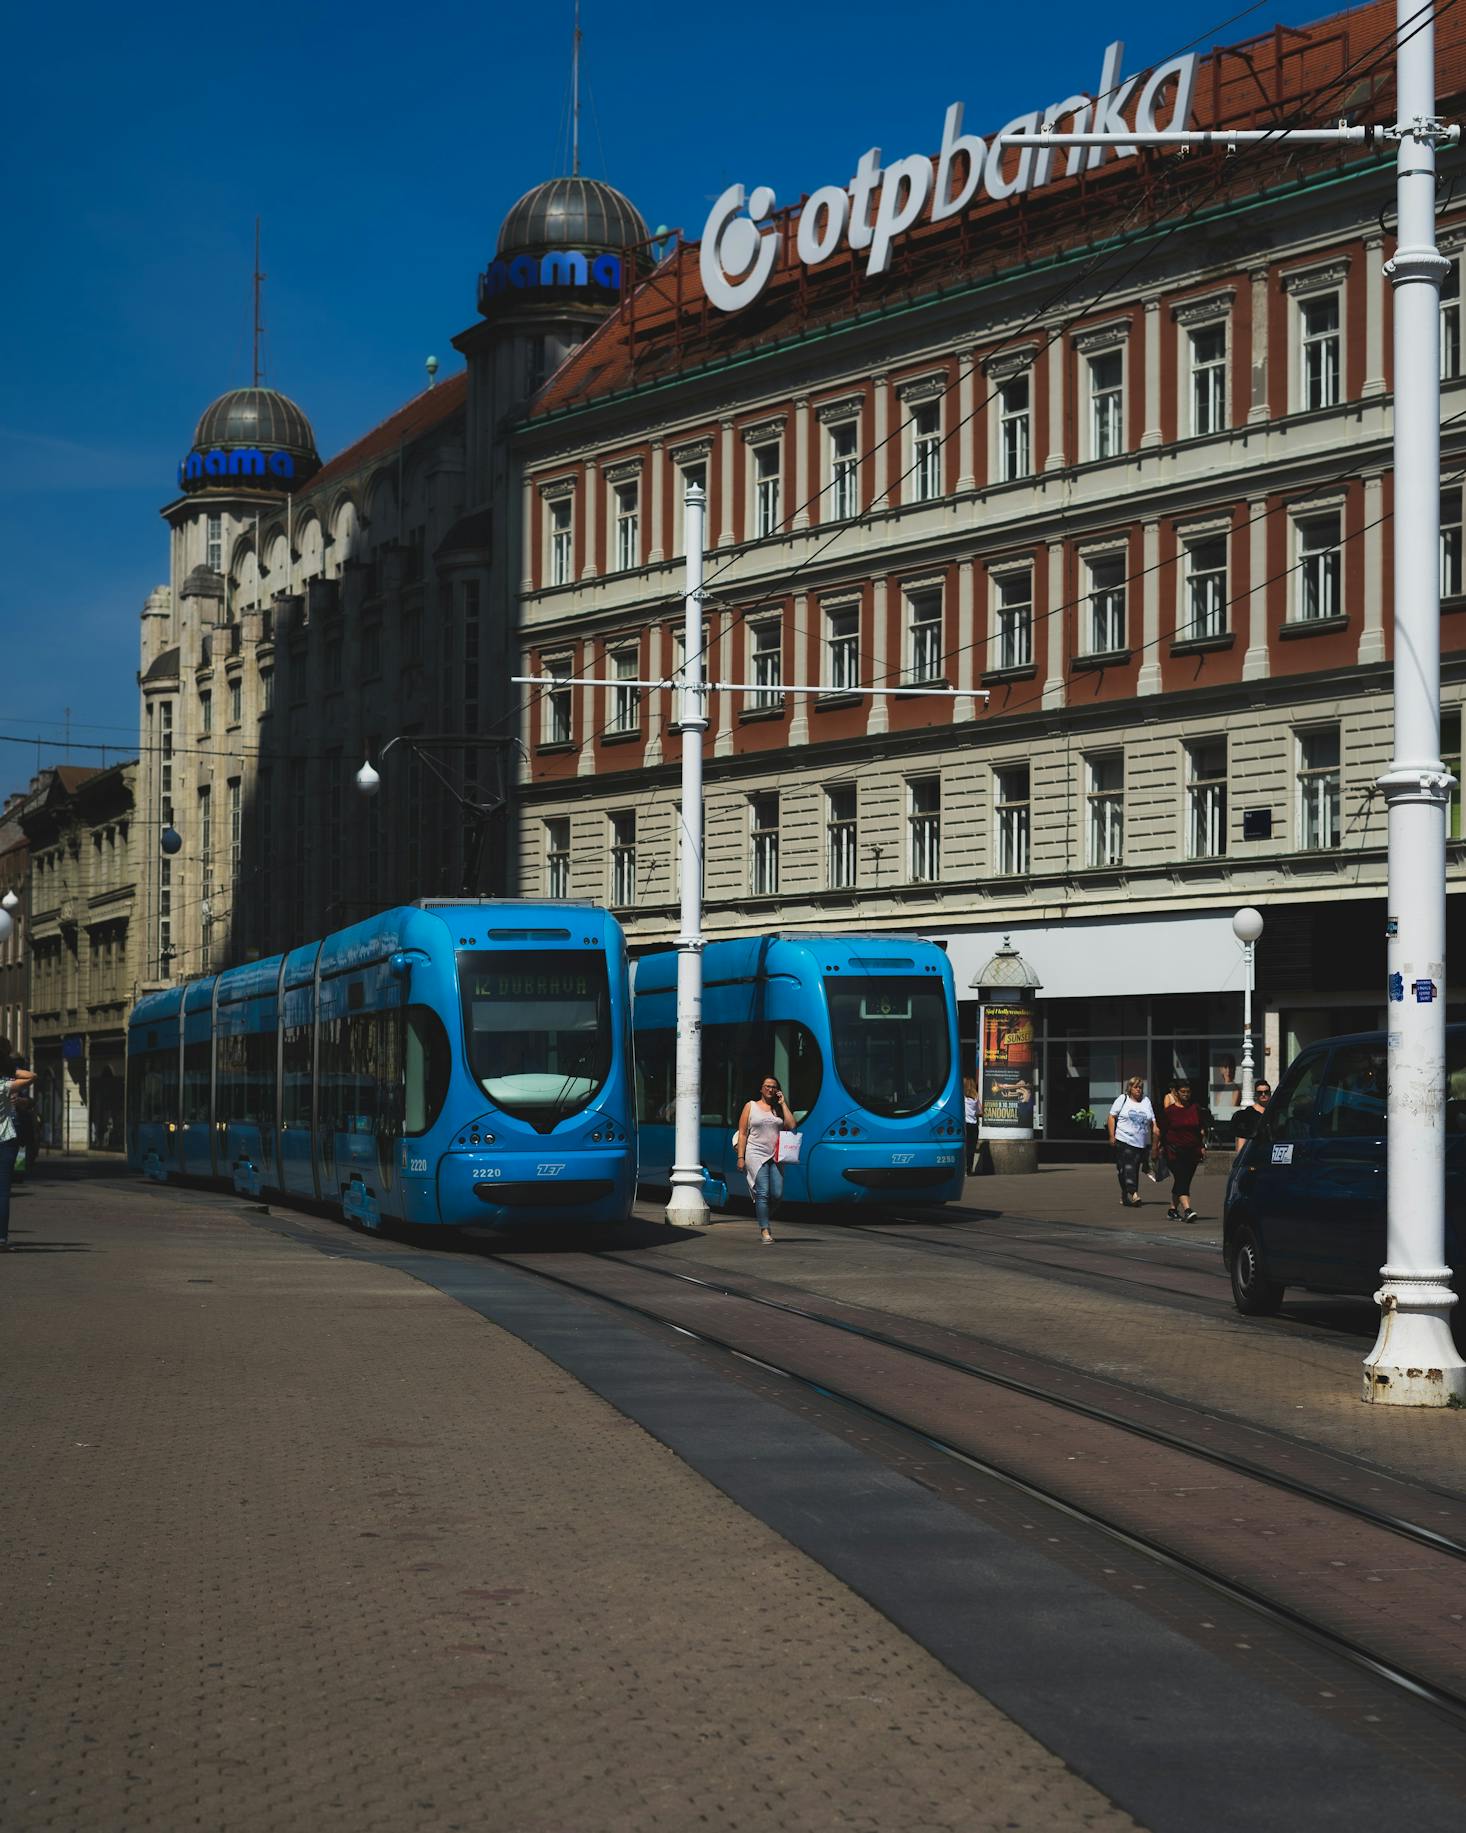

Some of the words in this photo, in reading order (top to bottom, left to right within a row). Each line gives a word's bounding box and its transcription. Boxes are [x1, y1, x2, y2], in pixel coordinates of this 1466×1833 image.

[186, 448, 295, 480] nama
[498, 976, 587, 995] DUBRAVA
[984, 1108, 1018, 1118] SANDOVAL
[411, 1159, 427, 1172] 2220
[892, 1153, 915, 1164] ZET
[472, 1168, 502, 1178] 2220
[537, 1163, 565, 1176] ZET
